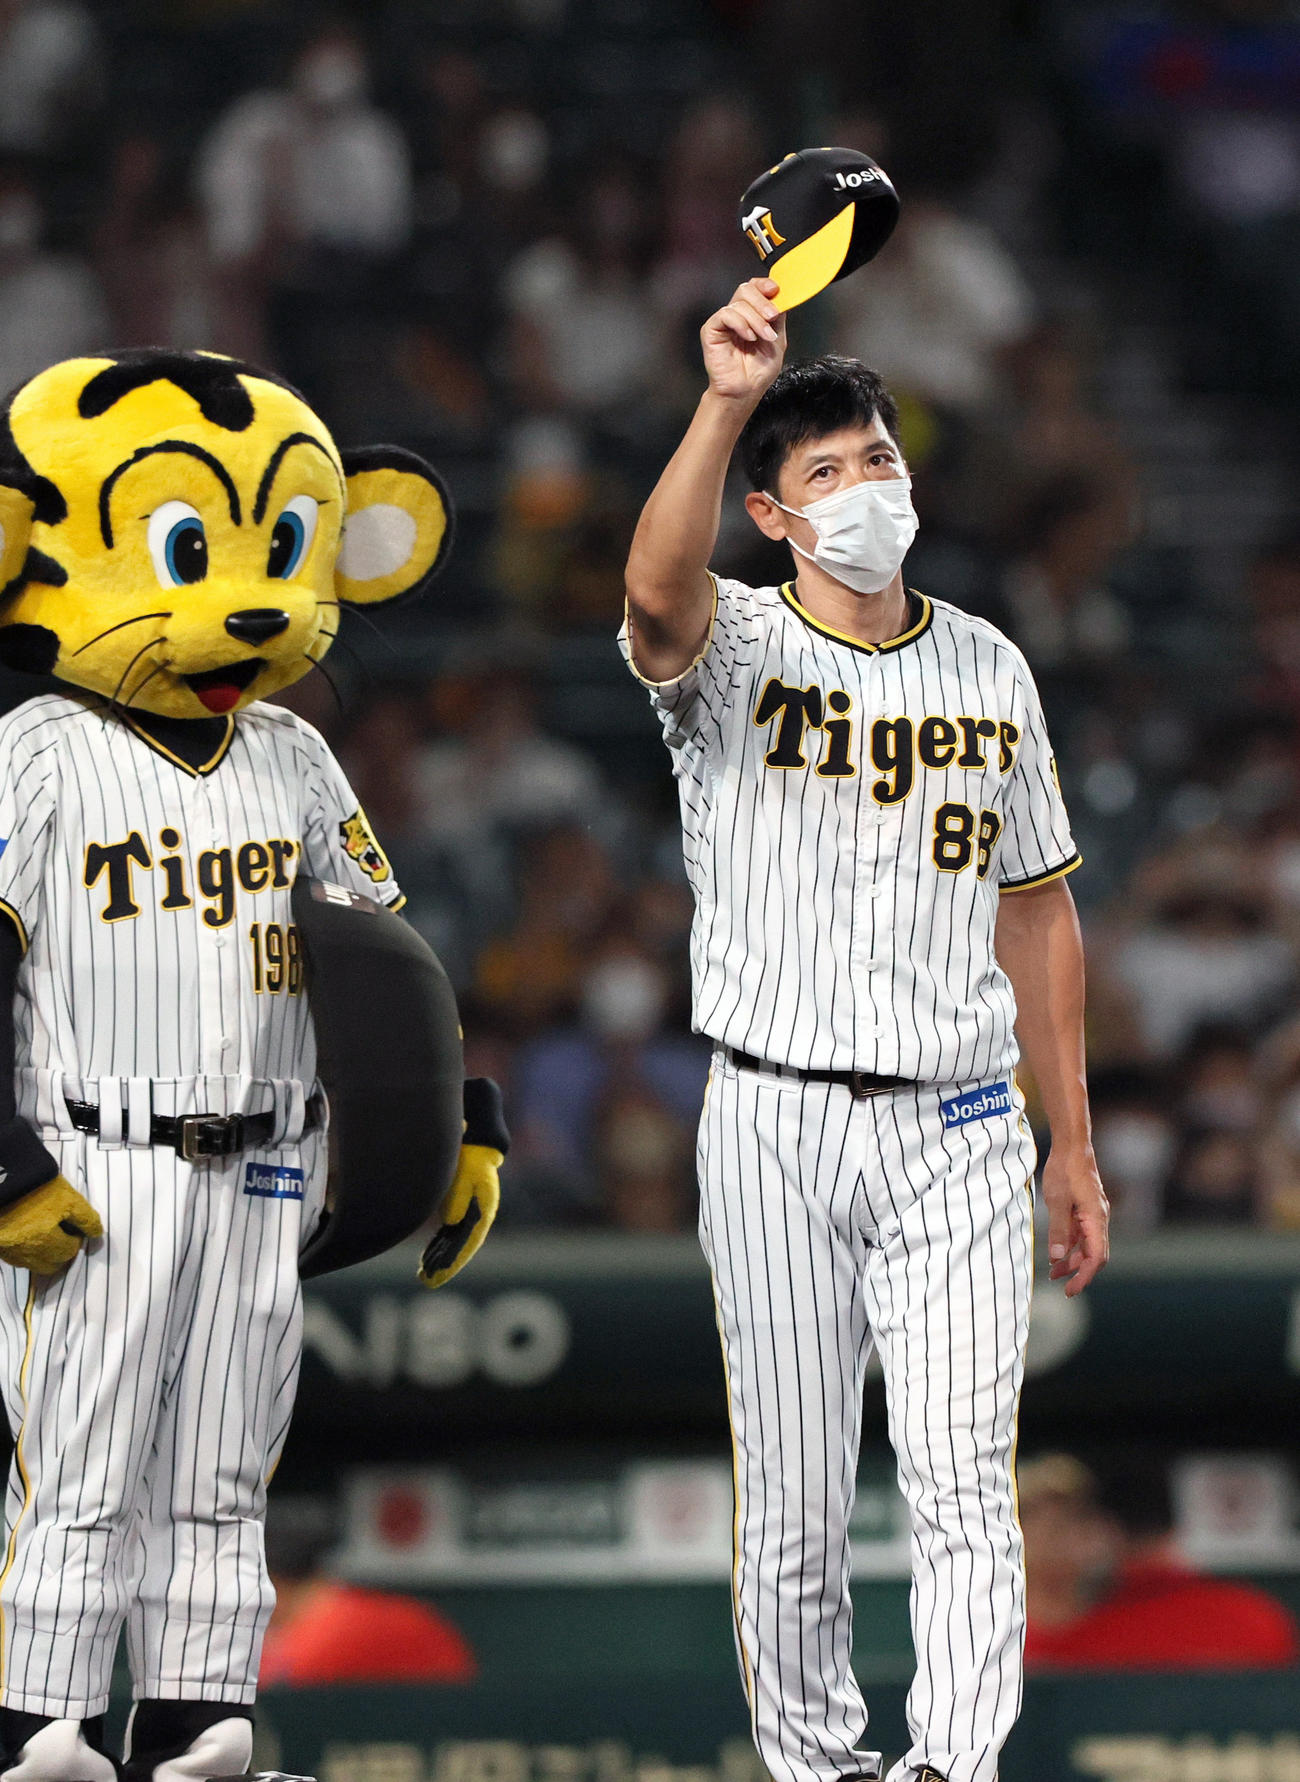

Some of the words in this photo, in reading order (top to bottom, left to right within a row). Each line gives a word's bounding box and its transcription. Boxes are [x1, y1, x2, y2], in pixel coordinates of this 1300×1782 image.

[833, 167, 894, 191] Josh
[752, 677, 1020, 807] Tigers
[931, 801, 1002, 882] 88
[82, 826, 302, 930] Tiger
[947, 1090, 1010, 1122] Joshin
[246, 1169, 303, 1193] Joshin
